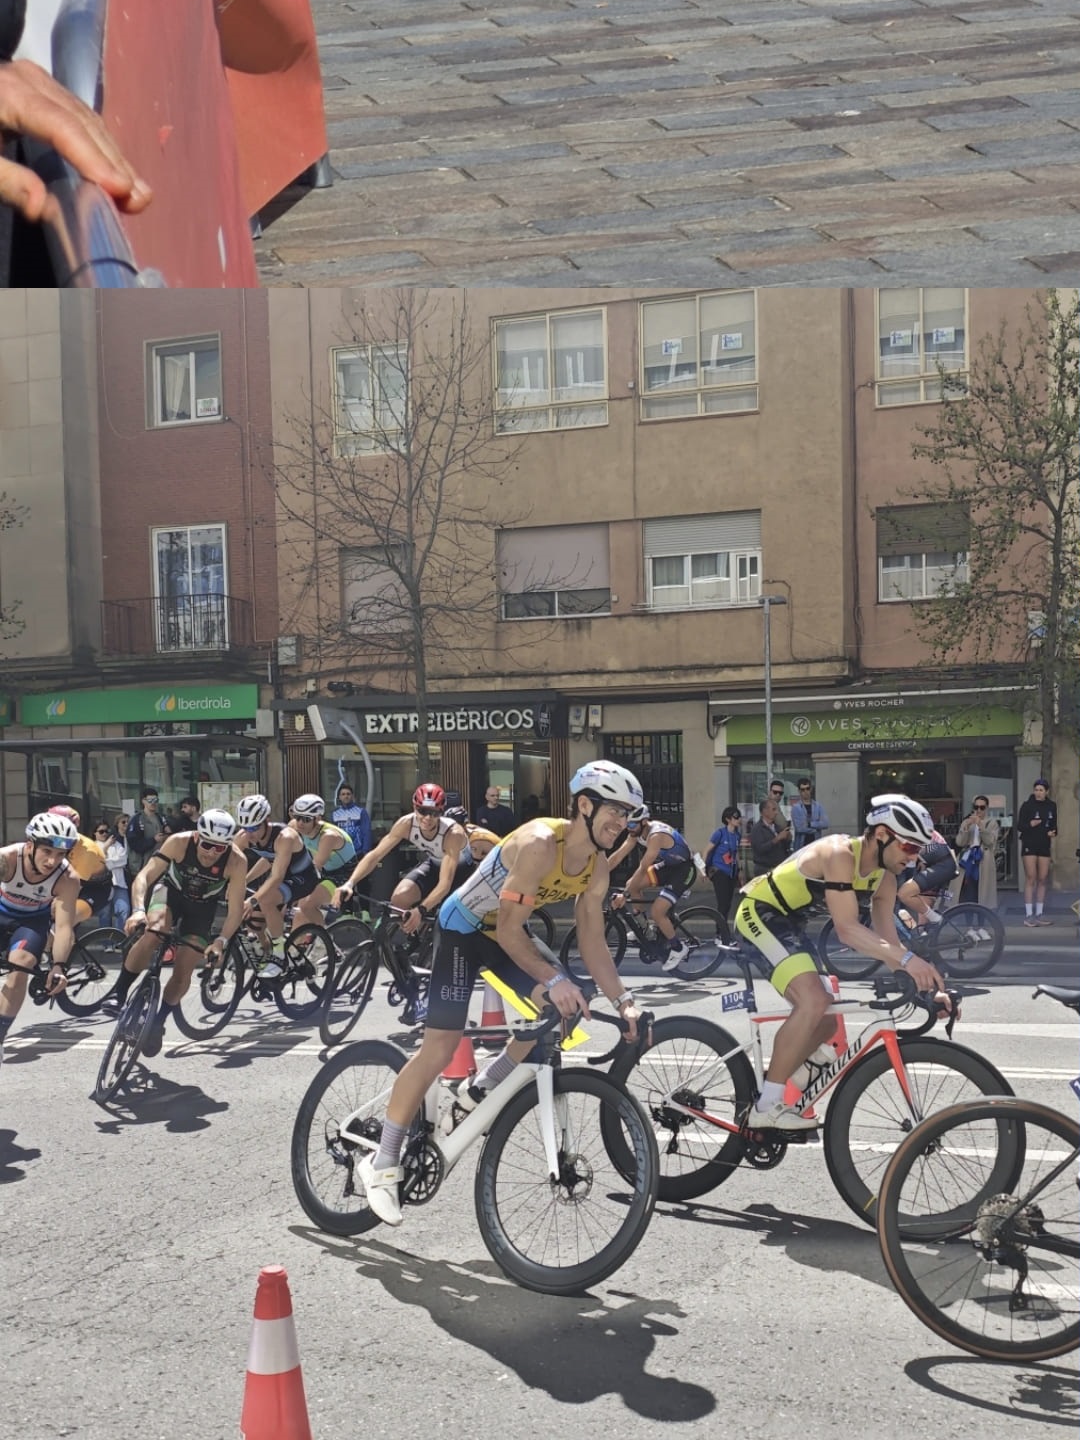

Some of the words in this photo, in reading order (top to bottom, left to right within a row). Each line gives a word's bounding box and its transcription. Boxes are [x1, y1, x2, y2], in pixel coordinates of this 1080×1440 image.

[177, 695, 232, 711] Iberdrola
[844, 700, 866, 709] YVES
[868, 698, 904, 707] ROCHER
[816, 718, 863, 731] YVES
[741, 906, 750, 922] TRI
[747, 921, 762, 938] 401
[723, 990, 744, 1004] 1104
